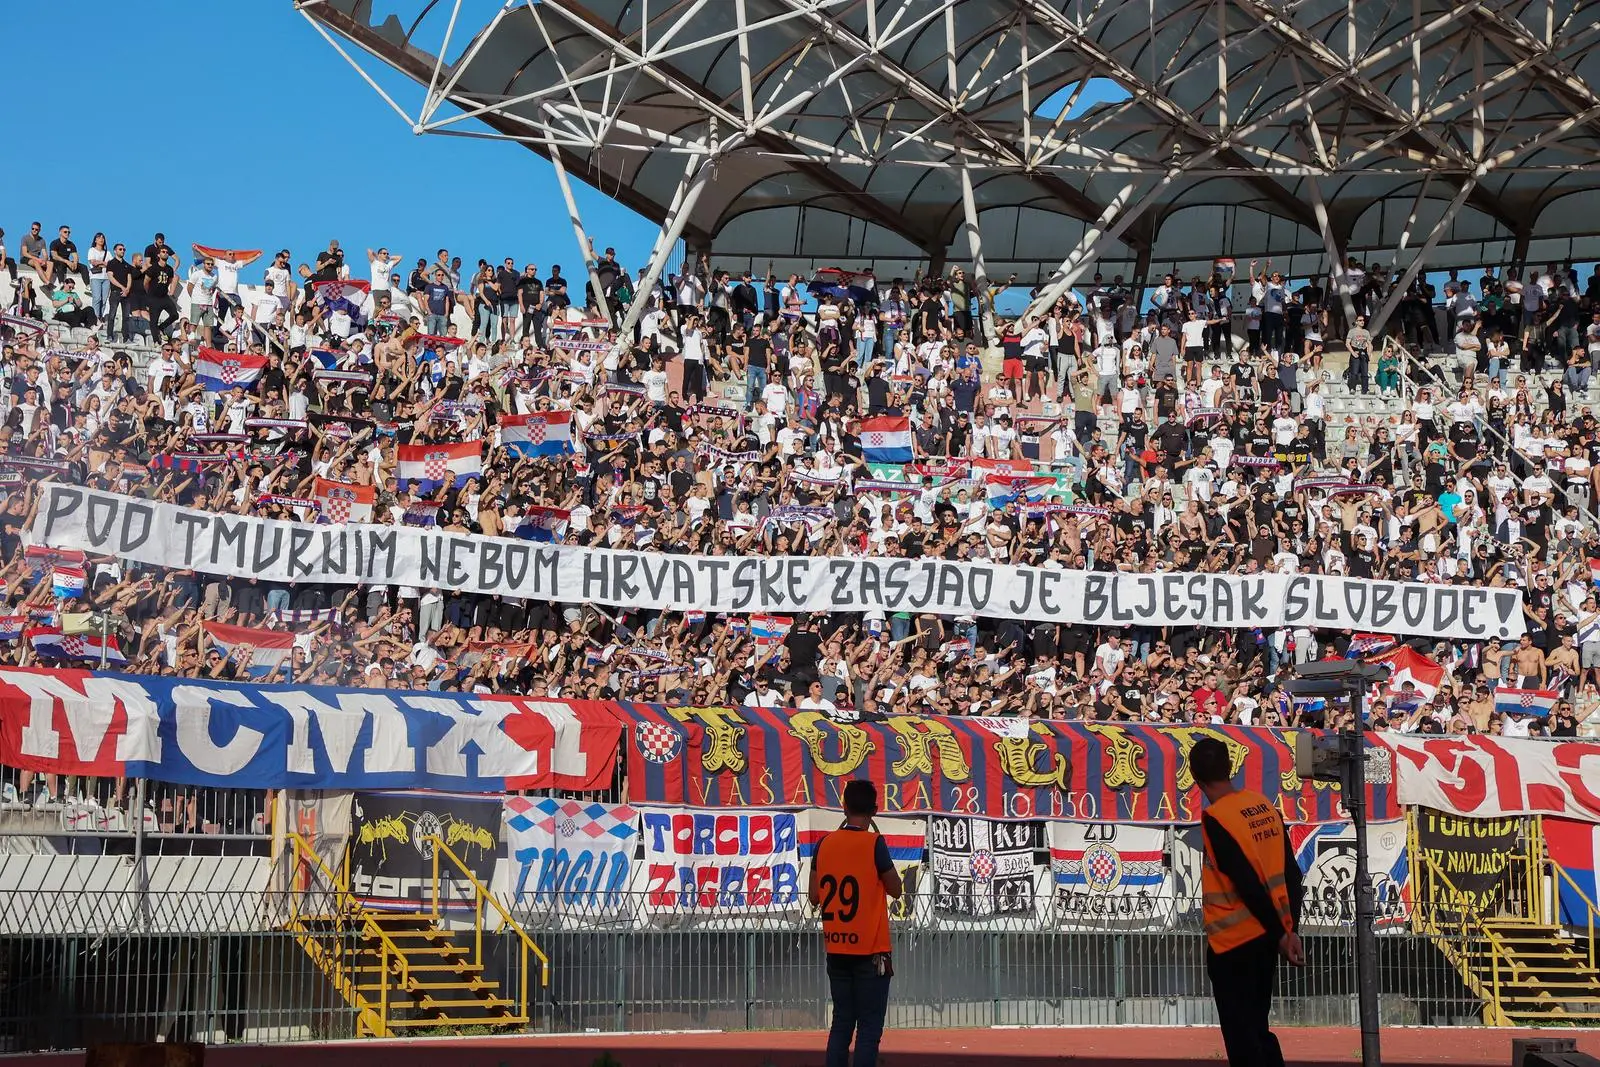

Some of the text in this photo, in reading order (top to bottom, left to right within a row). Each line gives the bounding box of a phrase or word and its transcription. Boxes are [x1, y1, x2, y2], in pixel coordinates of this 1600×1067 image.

[560, 341, 604, 350] HAJDUK
[271, 496, 315, 508] TORCIDA
[45, 487, 1517, 638] POD TMURNIM NEBOM HRVATSKE ZASJAO JE BLJESAK SLOBODE!
[0, 671, 587, 778] MCMXI
[643, 750, 675, 763] SPLIT
[692, 766, 812, 806] VAŠA
[950, 785, 986, 814] 28.
[1002, 792, 1034, 817] 10.
[1049, 786, 1099, 818] 1950.
[1240, 804, 1270, 819] REDAR
[644, 813, 796, 856] TORCIDA
[515, 847, 629, 908] TROGIR
[936, 857, 1030, 873] WHITE BOYS
[649, 863, 798, 907] ZAGREB
[820, 874, 859, 922] 29
[1057, 887, 1154, 915] REGIJA
[824, 932, 859, 945] HOTO
